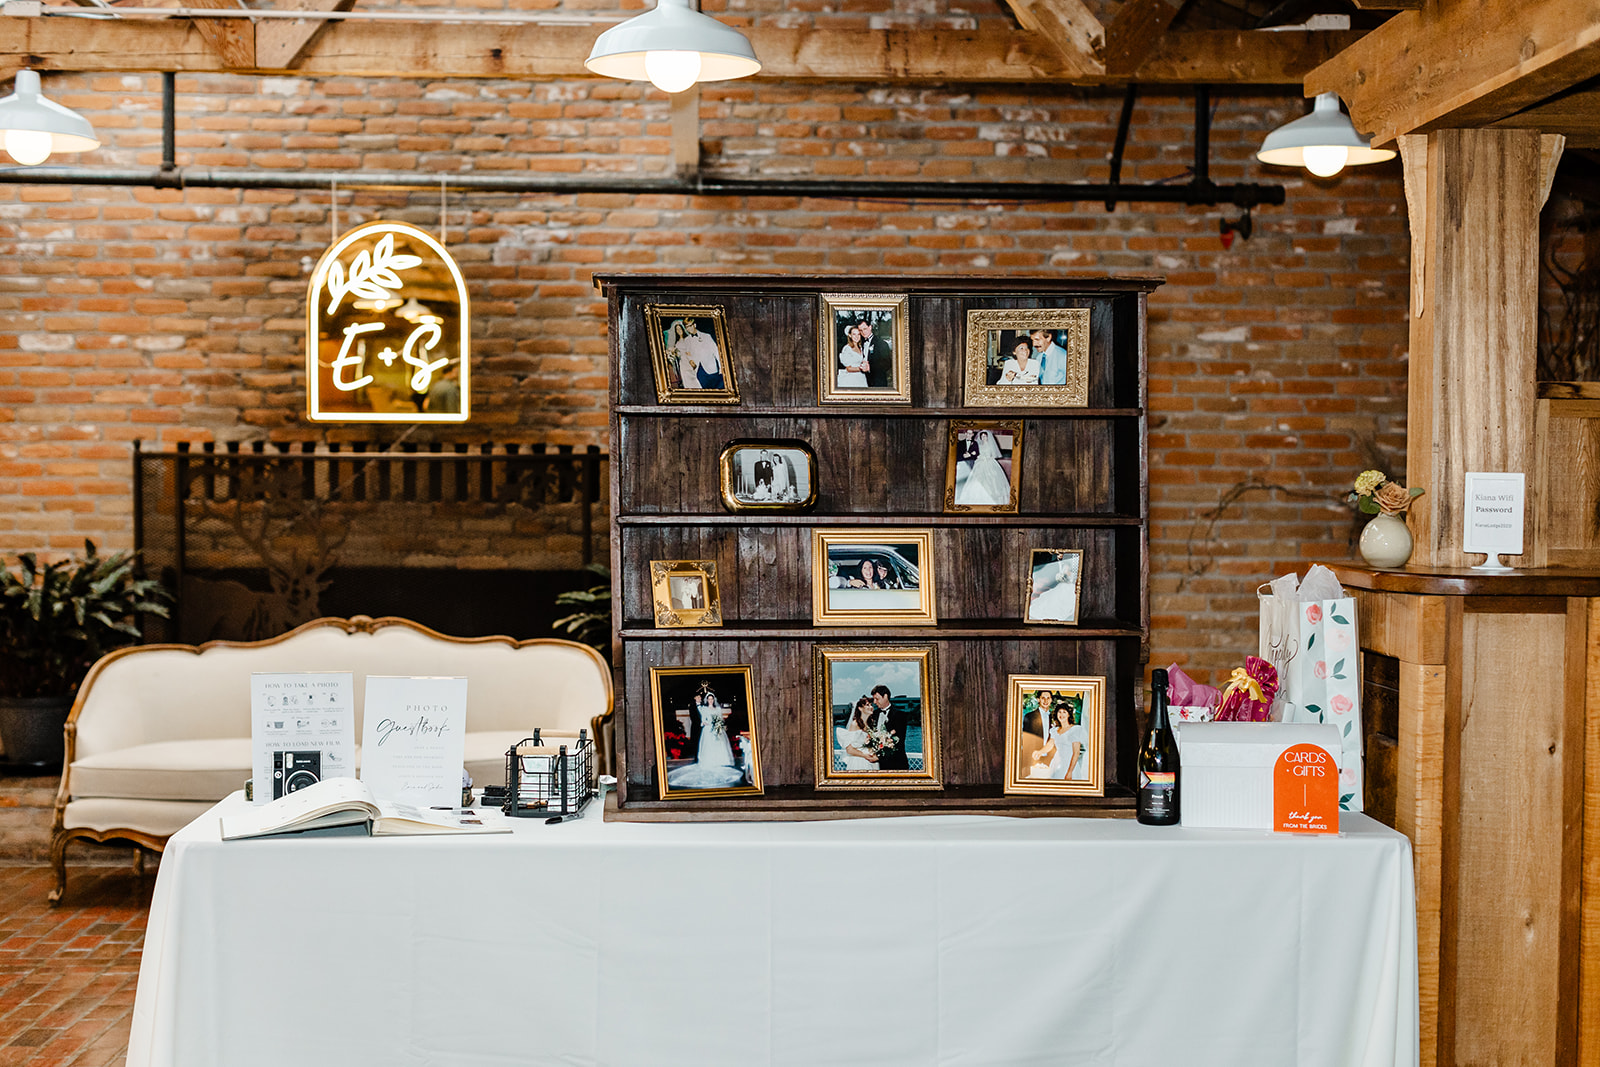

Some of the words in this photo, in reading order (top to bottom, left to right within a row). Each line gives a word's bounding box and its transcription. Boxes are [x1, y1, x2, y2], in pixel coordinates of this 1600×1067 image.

[406, 704, 448, 712] PHOTO
[1284, 751, 1326, 764] CARDS
[1293, 765, 1325, 777] GIFTS
[1288, 811, 1310, 820] thank
[1309, 816, 1323, 824] you
